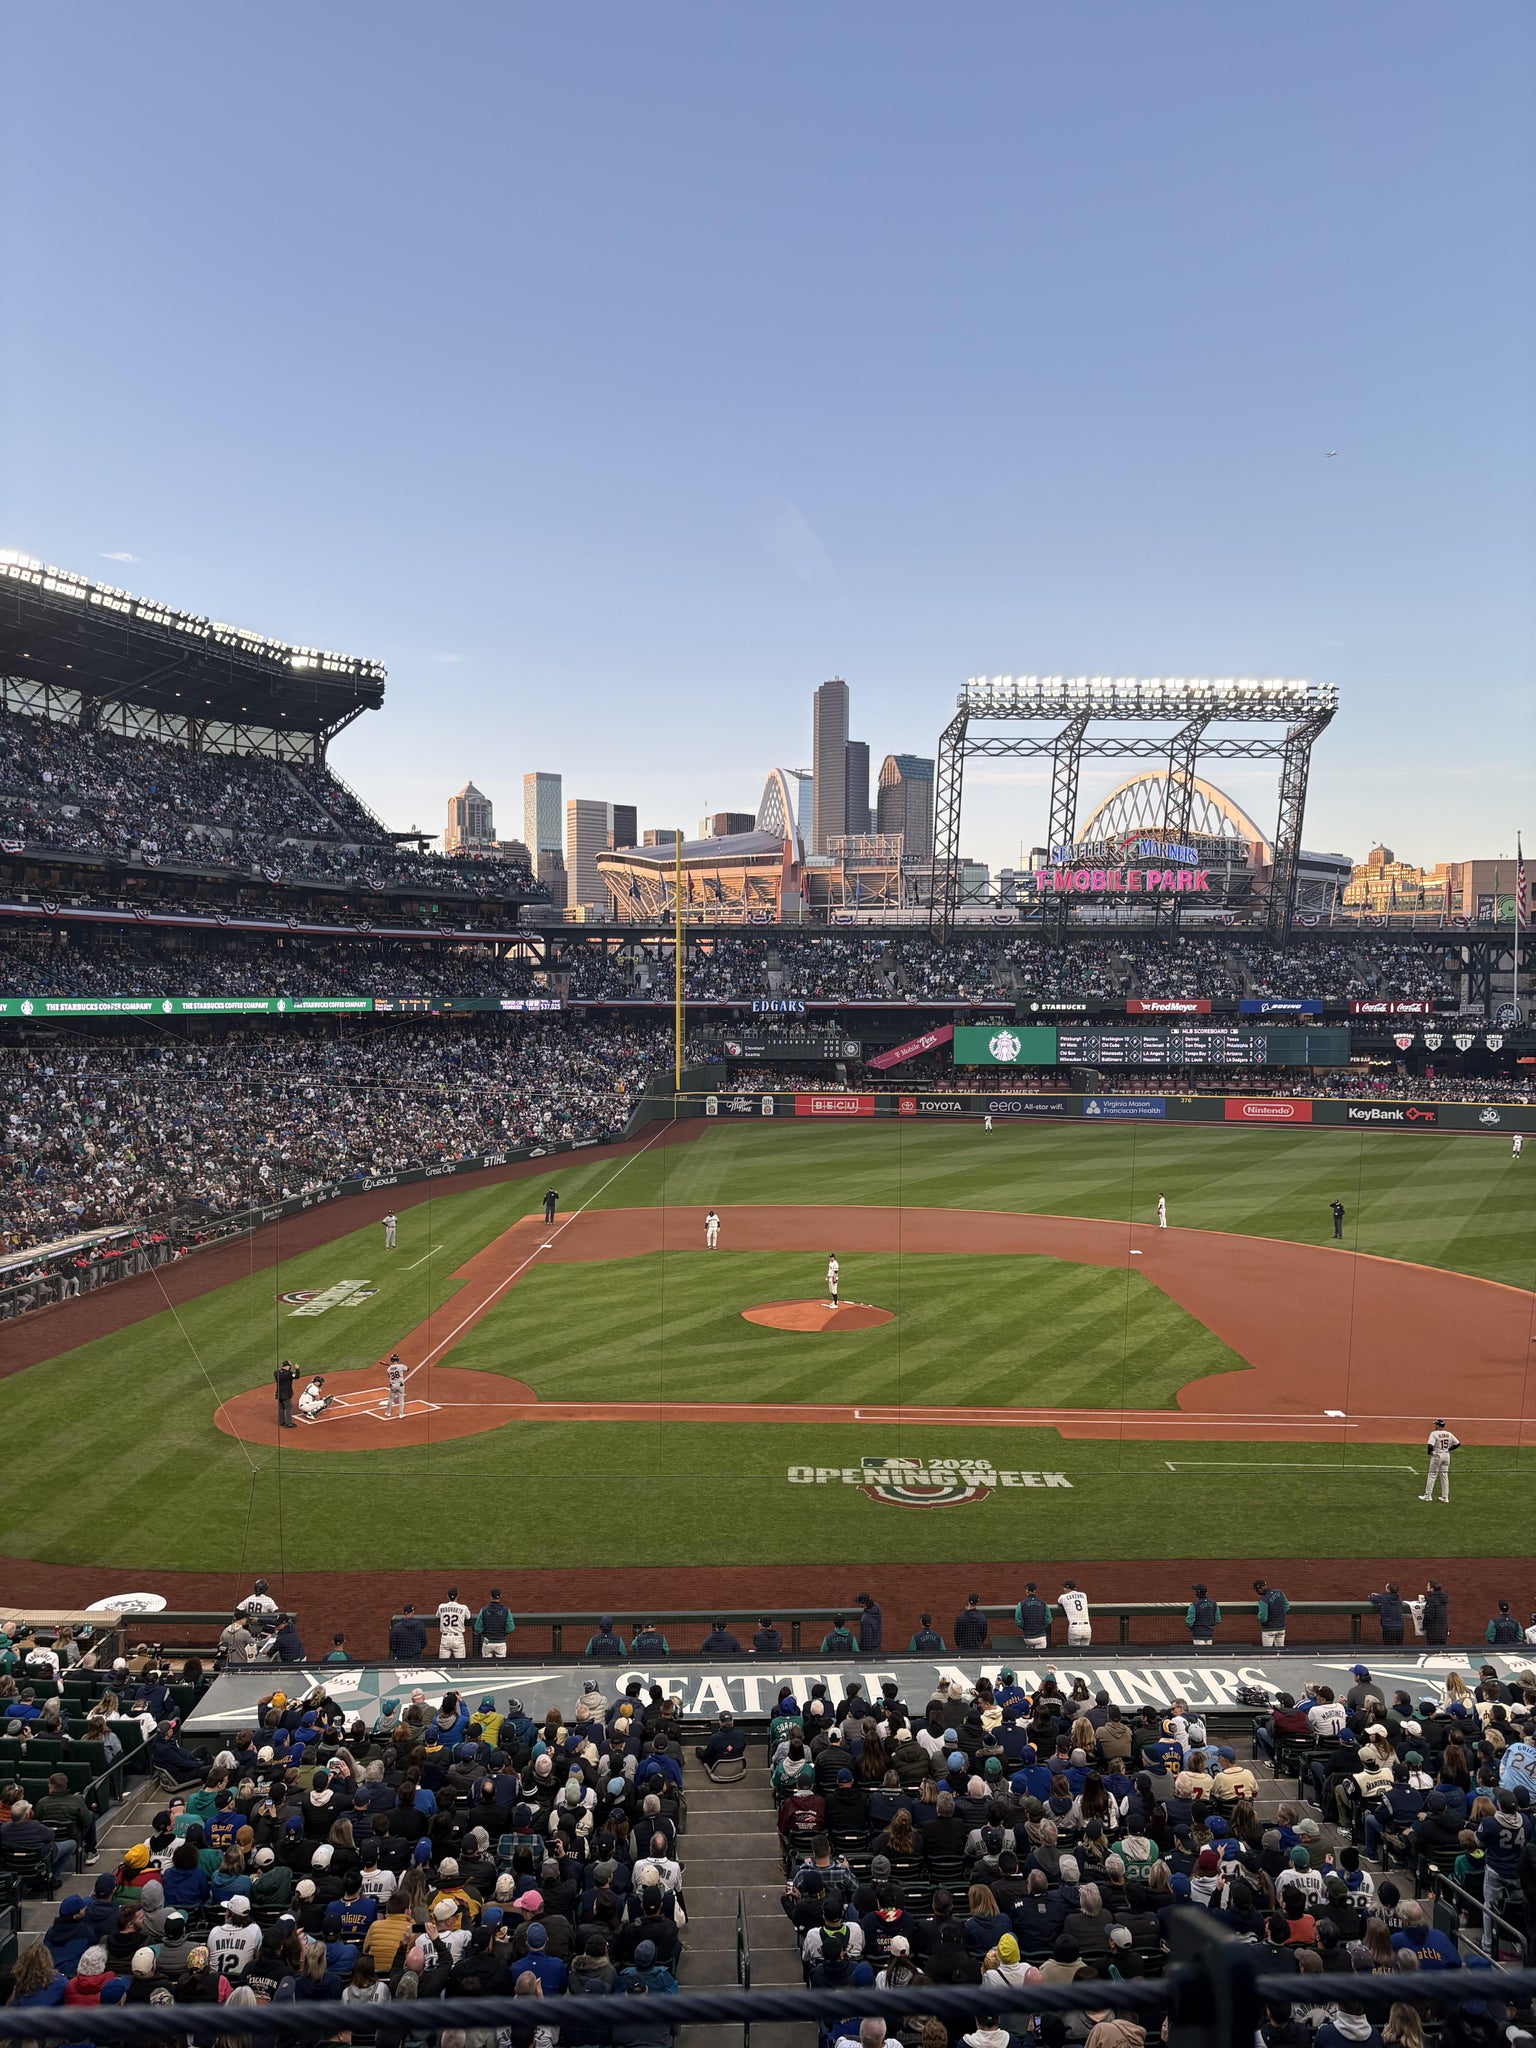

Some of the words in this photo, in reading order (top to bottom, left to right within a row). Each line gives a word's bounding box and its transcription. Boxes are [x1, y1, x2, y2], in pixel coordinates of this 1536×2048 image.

[1139, 838, 1199, 865] MARINERS
[1034, 869, 1142, 891] T-MOBILE
[1146, 869, 1211, 891] PARK
[46, 1003, 60, 1011] THE
[60, 1003, 98, 1011] STARBUCKS
[182, 1002, 194, 1010] THE
[193, 1002, 225, 1010] STARBUCKS
[1041, 1003, 1087, 1011] STARBUCKS
[900, 1043, 920, 1056] Mobile
[919, 1035, 937, 1048] Pen
[1398, 1039, 1409, 1047] 42
[1428, 1039, 1439, 1047] 24
[1459, 1039, 1468, 1047] 11
[1490, 1039, 1499, 1047] 51
[920, 1101, 962, 1111] TOYOTA
[989, 1101, 1022, 1112] eero
[1024, 1103, 1049, 1111] All-star
[1103, 1100, 1127, 1108] Virginia
[1246, 1105, 1290, 1115] Nintendo
[1348, 1108, 1404, 1121] KeyBank
[1482, 1110, 1497, 1120] 50
[483, 1153, 507, 1167] STIHL
[425, 1167, 442, 1177] Great
[442, 1164, 456, 1175] Clips
[372, 1176, 398, 1187] LEXUS
[390, 1371, 401, 1380] 38
[1440, 1439, 1449, 1450] 15
[928, 1459, 993, 1470] 2026
[787, 1466, 958, 1487] OPENING
[960, 1470, 1075, 1488] WEEK
[1074, 1599, 1083, 1611] 8
[443, 1614, 459, 1627] 32
[615, 1671, 908, 1715] SEATTLE
[1321, 1709, 1344, 1721] MARTINEZ
[1331, 1719, 1341, 1736] 11
[1510, 1752, 1536, 1777] 24
[1192, 1786, 1204, 1800] 7
[1233, 1784, 1245, 1799] 5
[1498, 1828, 1526, 1849] 24
[362, 1882, 383, 1894] AYLOR
[341, 1912, 367, 1925] RÍGUEZ
[215, 1938, 247, 1951] NAYLOR
[1417, 1947, 1442, 1962] attle
[217, 1953, 239, 1973] 12
[249, 1976, 278, 1988] EXCALIBUR
